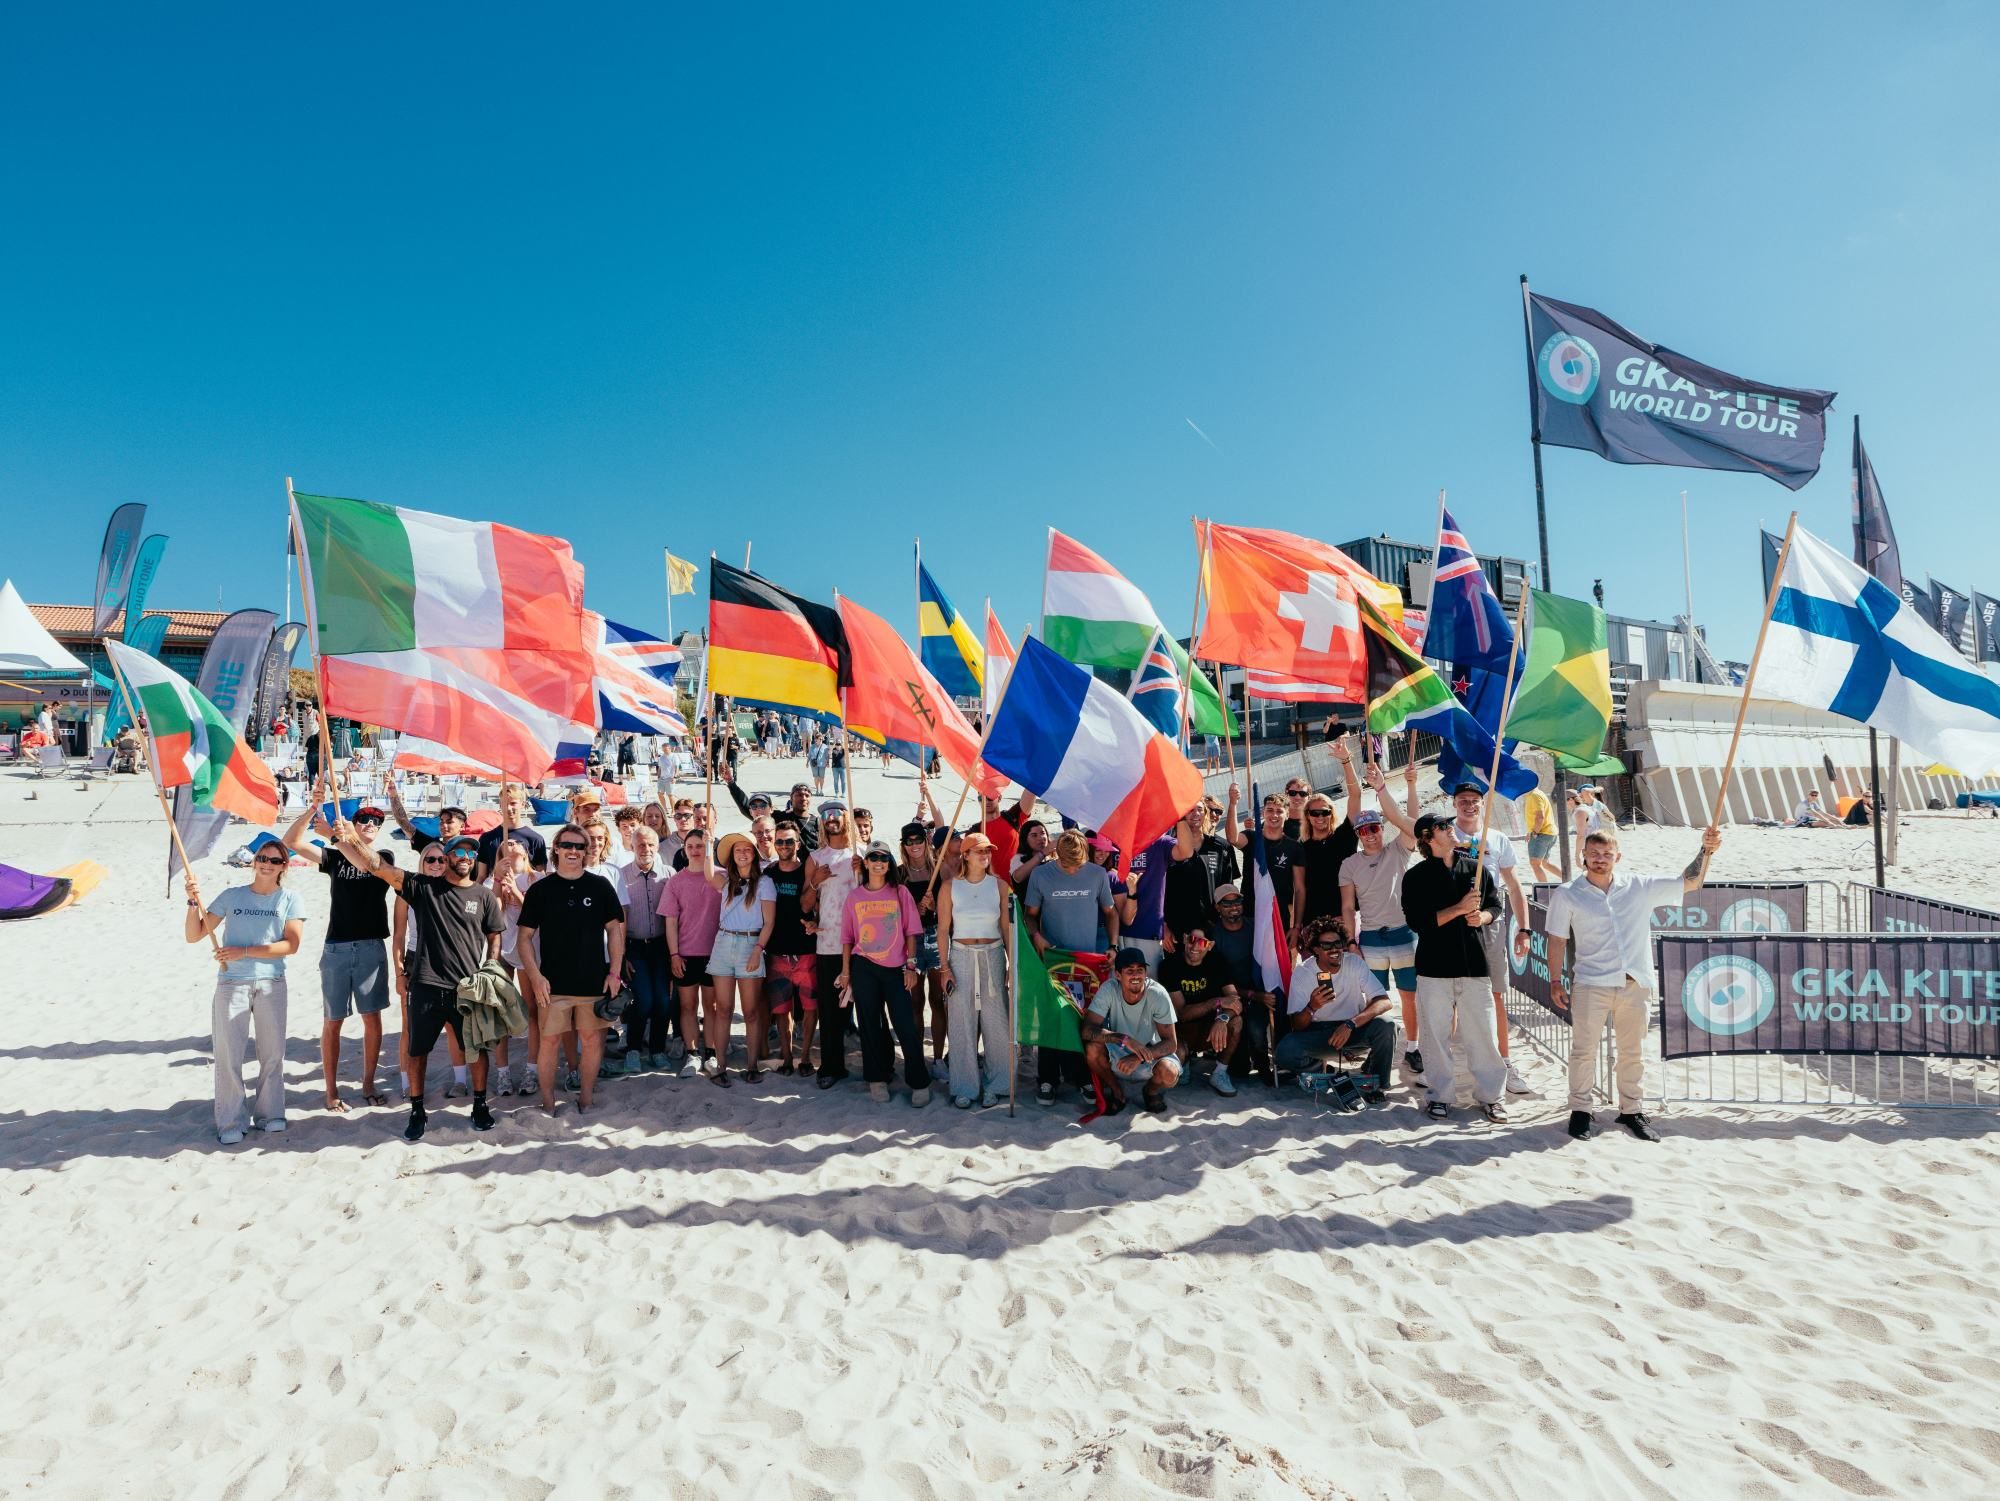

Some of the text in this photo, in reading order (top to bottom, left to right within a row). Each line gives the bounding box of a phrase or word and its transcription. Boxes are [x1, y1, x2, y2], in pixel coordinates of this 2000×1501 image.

[1616, 357, 1697, 397] GKA
[1609, 389, 1799, 438] WORLD TOUR
[134, 557, 155, 611] DUOTONE
[244, 908, 280, 917] DUOTONE
[1530, 931, 1548, 959] GK
[1531, 957, 1551, 982] WOR
[1792, 967, 1890, 998] GKA
[1793, 1002, 1912, 1023] WORLD
